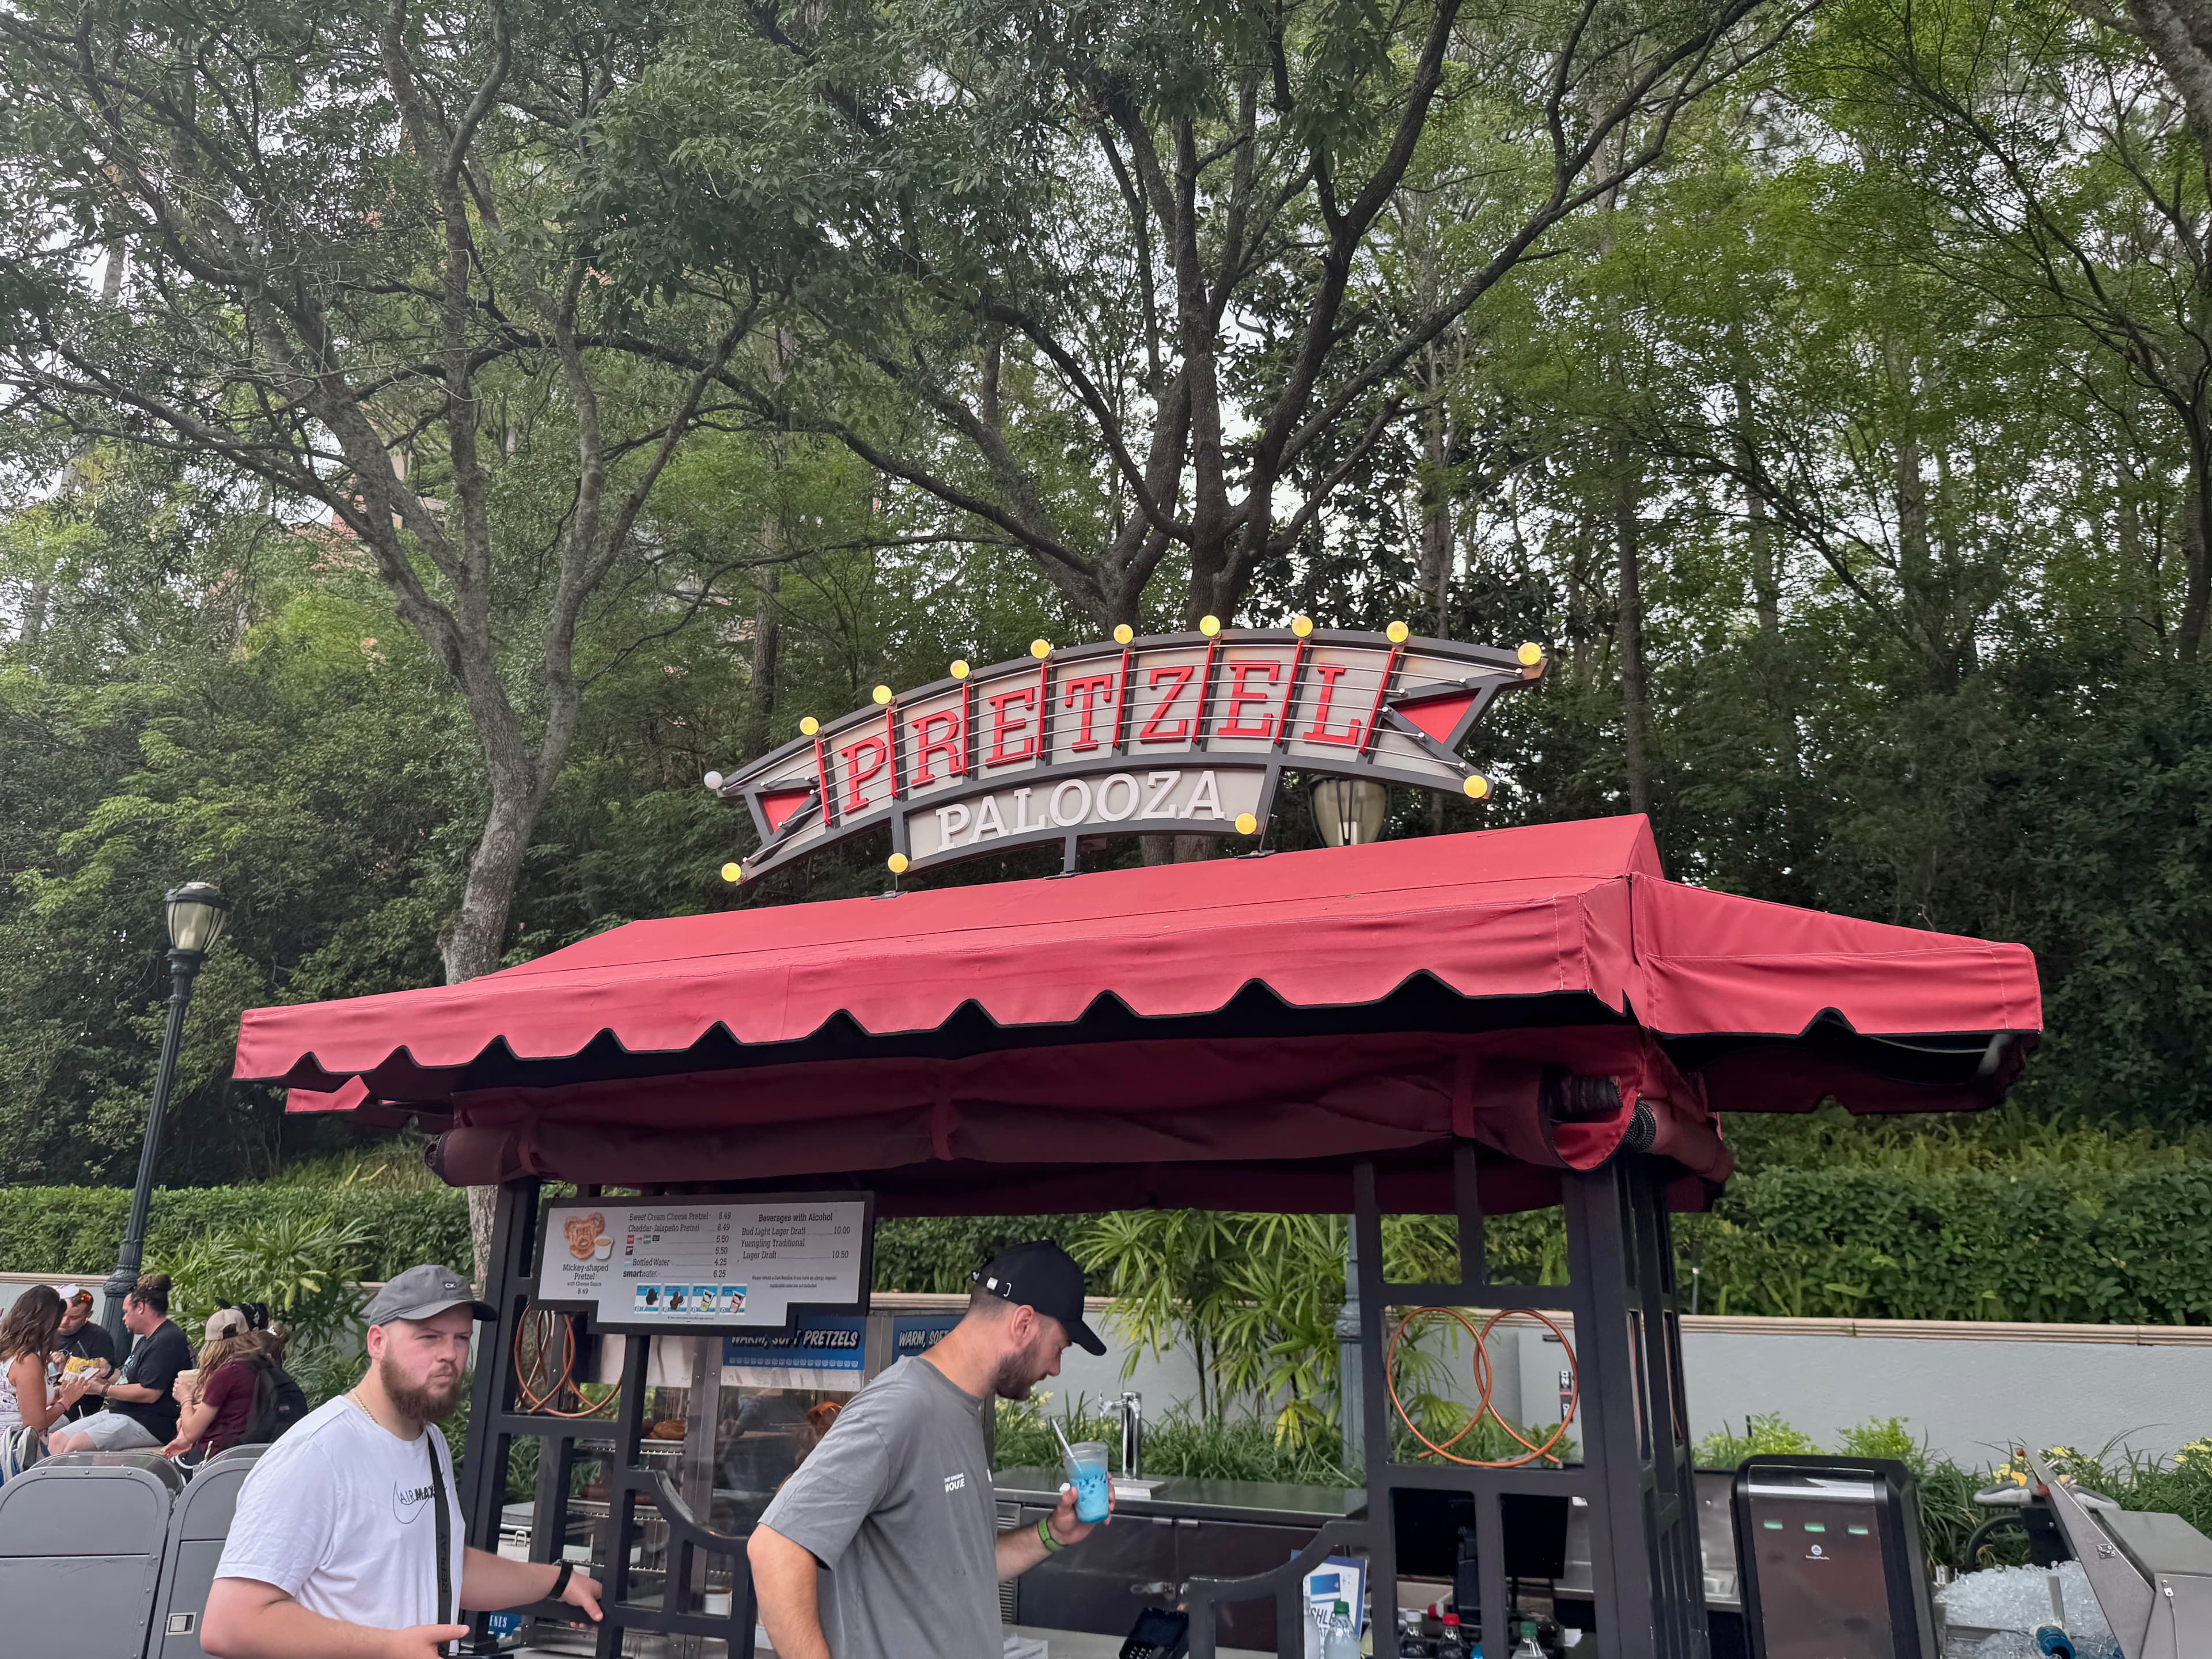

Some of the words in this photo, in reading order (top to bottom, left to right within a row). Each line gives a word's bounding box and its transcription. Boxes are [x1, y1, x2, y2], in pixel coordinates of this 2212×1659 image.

[841, 660, 1362, 813] PRETZEL
[935, 770, 1226, 850] PALOOZA
[689, 1212, 709, 1220] Pretzel
[759, 1214, 791, 1224] Beverages
[793, 1213, 806, 1221] with
[808, 1212, 833, 1221] Alcohol
[680, 1224, 699, 1232] Pretzel
[742, 1227, 753, 1235] Bud
[755, 1227, 770, 1236] Light
[772, 1228, 789, 1237] Lager
[790, 1227, 805, 1235] Draft
[834, 1226, 850, 1234] 10.00
[716, 1235, 729, 1243] 5.50
[741, 1239, 771, 1248] Yuengling
[772, 1238, 805, 1247] Traditional
[715, 1247, 728, 1255] 5.50
[743, 1251, 760, 1260] Lager
[762, 1251, 777, 1259] Draft
[832, 1250, 849, 1258] 10.50
[632, 1258, 652, 1266] Bottled
[653, 1258, 670, 1266] Water
[714, 1258, 727, 1266] 4.25
[562, 1264, 608, 1272] Mickey-shaped
[713, 1270, 726, 1278] 6.25
[803, 1330, 858, 1347] PRETZELS
[899, 1331, 926, 1348] WARM,
